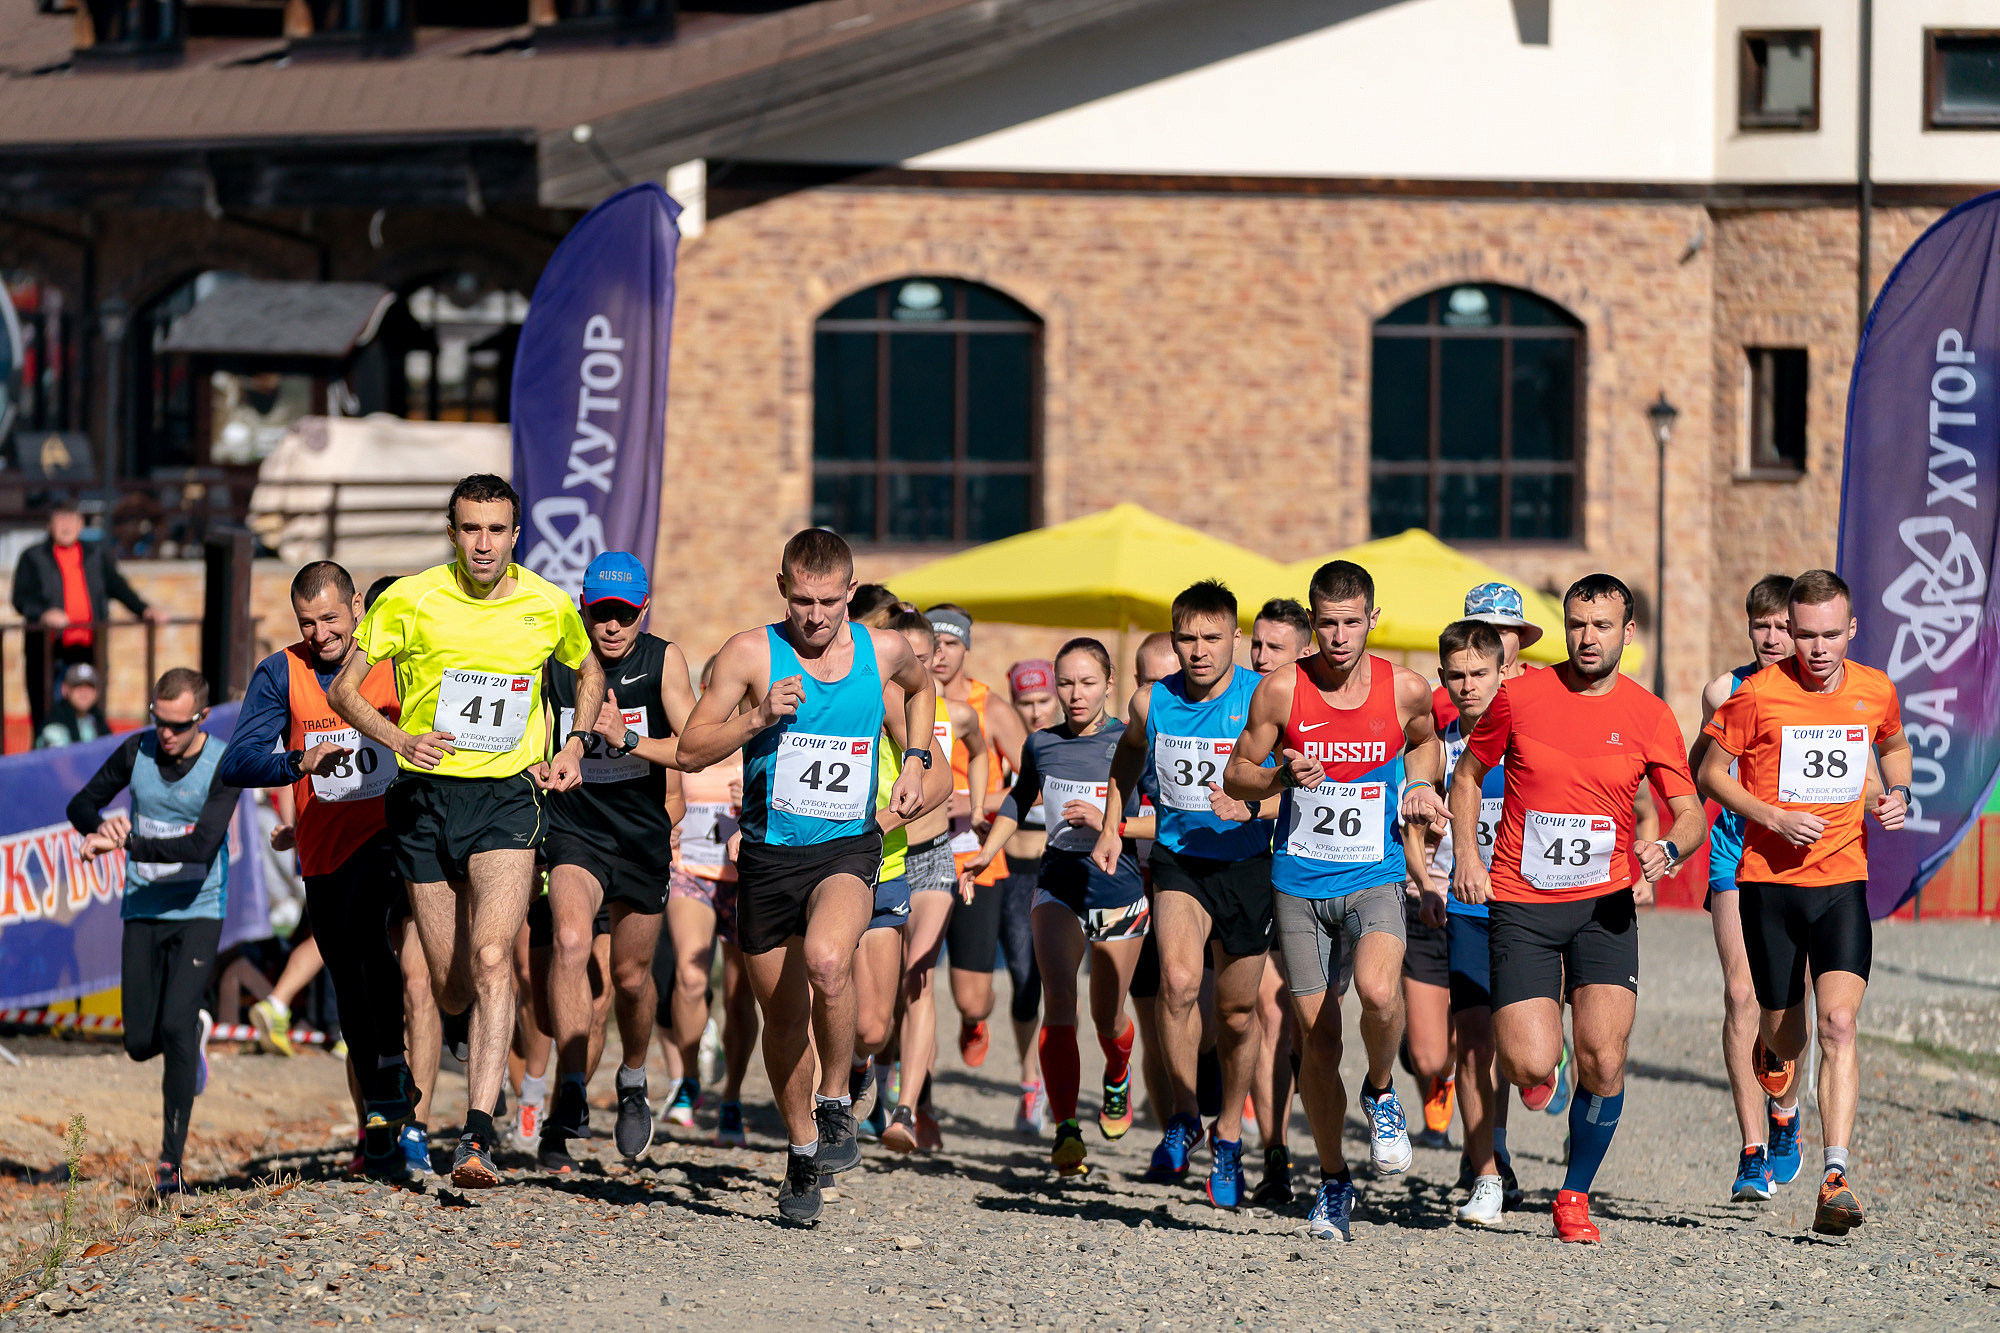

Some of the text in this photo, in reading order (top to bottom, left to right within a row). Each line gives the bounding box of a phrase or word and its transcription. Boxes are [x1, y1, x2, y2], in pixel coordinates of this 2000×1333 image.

[562, 313, 625, 494] ХУТОР
[599, 570, 633, 583] RUSSIA
[1903, 327, 1978, 834] РОЗА ХУТОР
[454, 673, 508, 688] СОЧИ '20
[459, 695, 506, 727] 41
[302, 717, 337, 731] TRACK
[460, 732, 487, 742] КУБОК
[1793, 729, 1842, 740] СОЧИ '20
[791, 736, 847, 751] СОЧИ '20
[1164, 738, 1209, 751] СОЧИ '20
[1303, 741, 1386, 763] RUSSIA
[1803, 749, 1848, 778] 38
[799, 760, 851, 793] 42
[1173, 759, 1217, 787] 32
[1050, 781, 1074, 793] СОЧИ
[1339, 787, 1357, 798] '20
[1831, 786, 1858, 794] РОССИИ
[795, 806, 808, 815] ПО
[808, 808, 846, 818] ГОРНОМУ
[800, 799, 859, 811] КУБОК РОССИИ
[1312, 806, 1362, 837] 26
[1535, 814, 1586, 828] СОЧИ '20
[1310, 850, 1323, 858] ПО
[1324, 852, 1361, 860] ГОРНОМУ
[1315, 843, 1375, 853] КУБОК РОССИИ
[1543, 838, 1591, 867] 43
[1546, 873, 1573, 881] КУБОК
